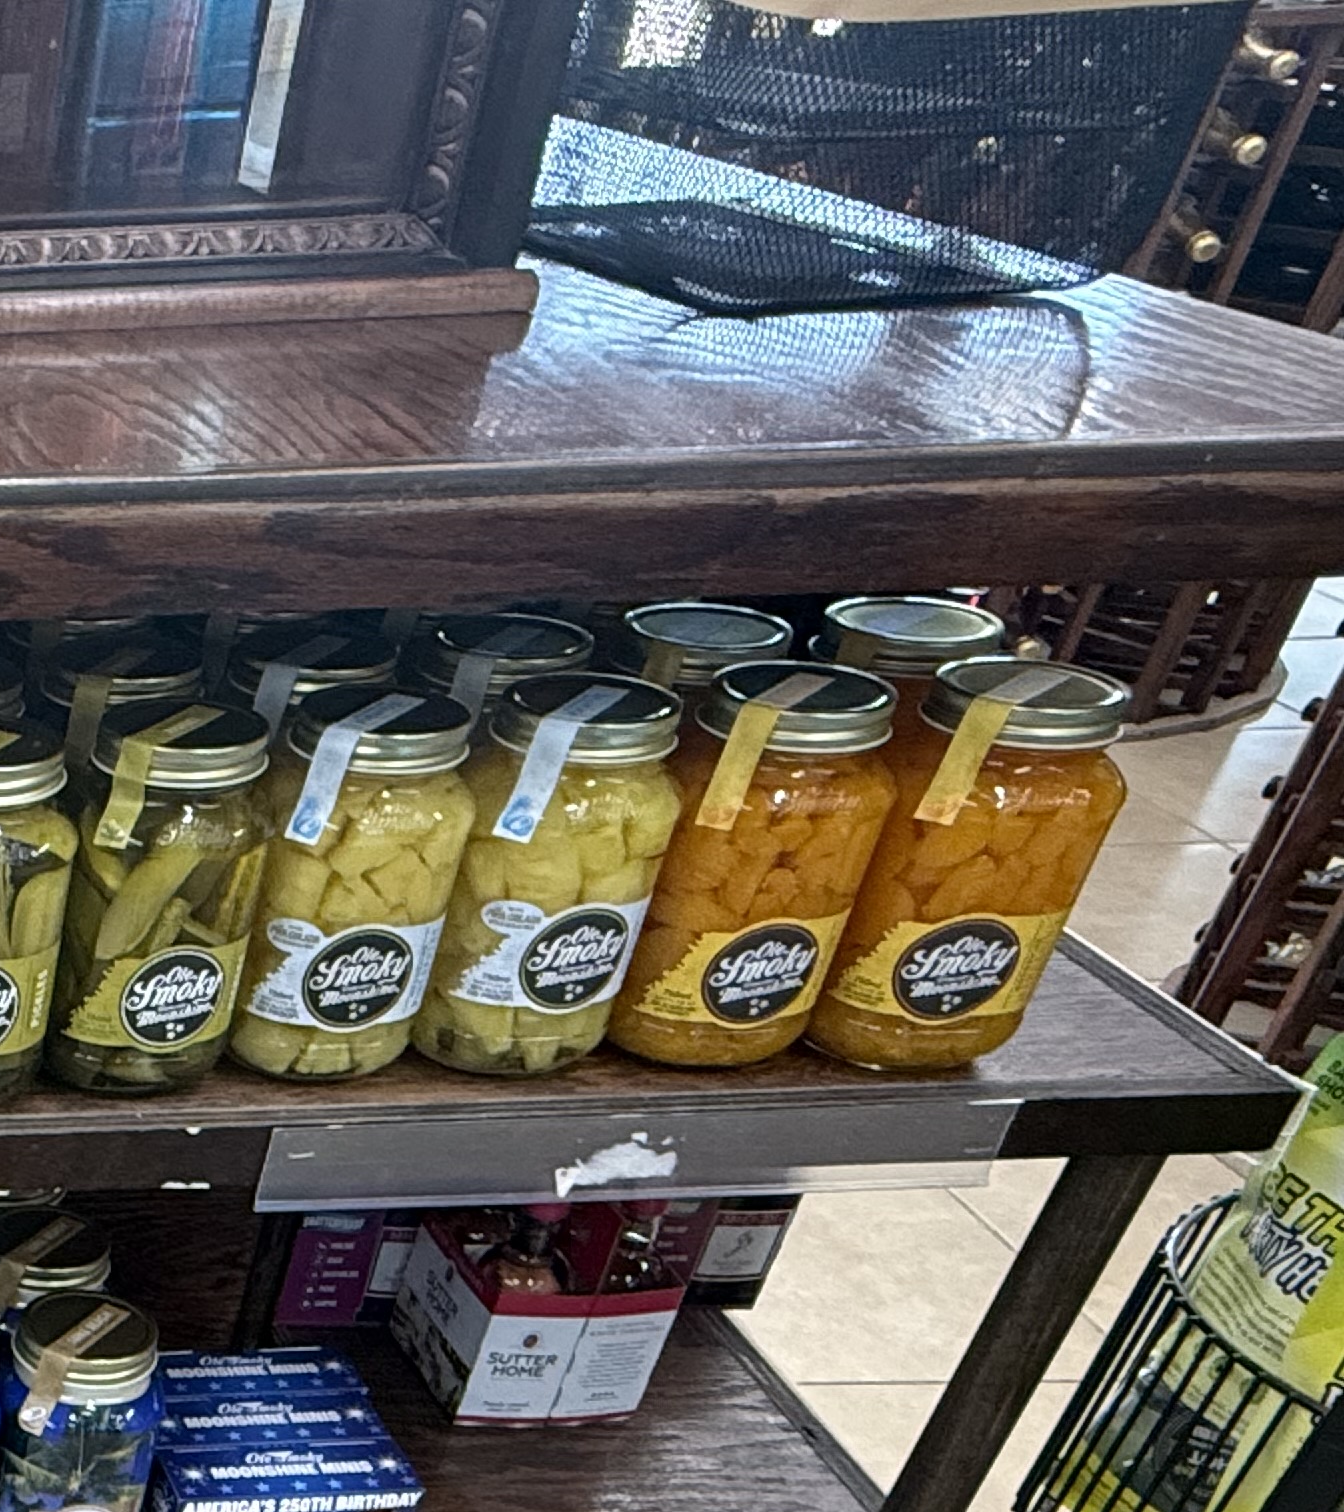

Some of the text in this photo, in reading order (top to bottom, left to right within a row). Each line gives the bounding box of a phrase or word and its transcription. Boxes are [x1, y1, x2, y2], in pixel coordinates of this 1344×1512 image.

[571, 926, 606, 944] Ole
[352, 946, 382, 965] Ole
[527, 930, 625, 968] Smoky
[759, 942, 788, 961] Ole
[956, 937, 986, 956] Ole
[309, 953, 410, 991] Smoky
[711, 945, 817, 987] Smoky
[901, 942, 1018, 983] Smoky
[164, 967, 197, 988] Ole
[29, 969, 49, 1029] PICKLES
[127, 975, 219, 1010] Smoky
[486, 1351, 558, 1367] SUTTER
[491, 1365, 545, 1379] HOME
[279, 1496, 333, 1512] 250TH
[336, 1491, 423, 1511] BIRTHDAY
